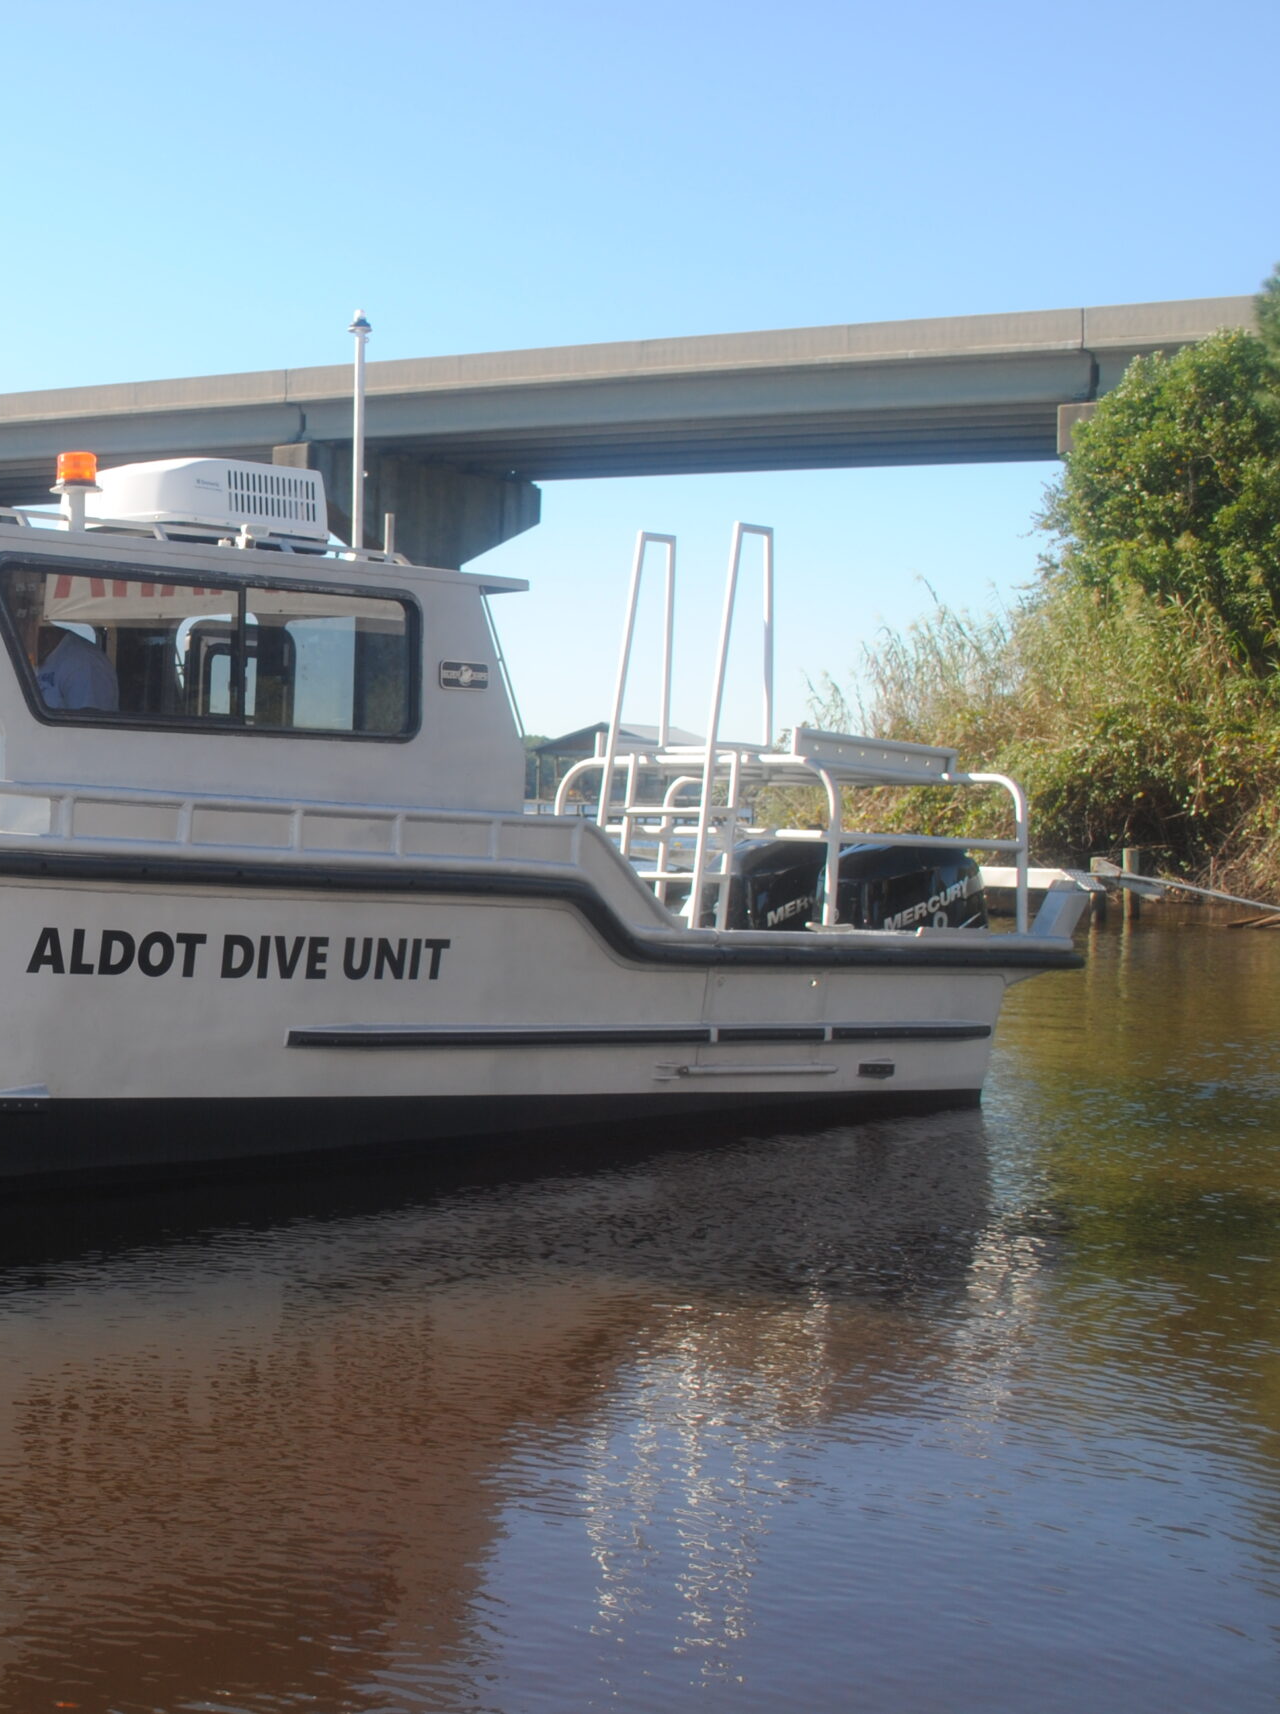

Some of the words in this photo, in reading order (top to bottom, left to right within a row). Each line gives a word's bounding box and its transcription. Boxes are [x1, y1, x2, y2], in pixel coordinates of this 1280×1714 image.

[884, 876, 969, 930] MERCURY
[26, 927, 207, 978] ALDOT
[220, 934, 329, 980] DIVE
[343, 937, 451, 981] UNIT
